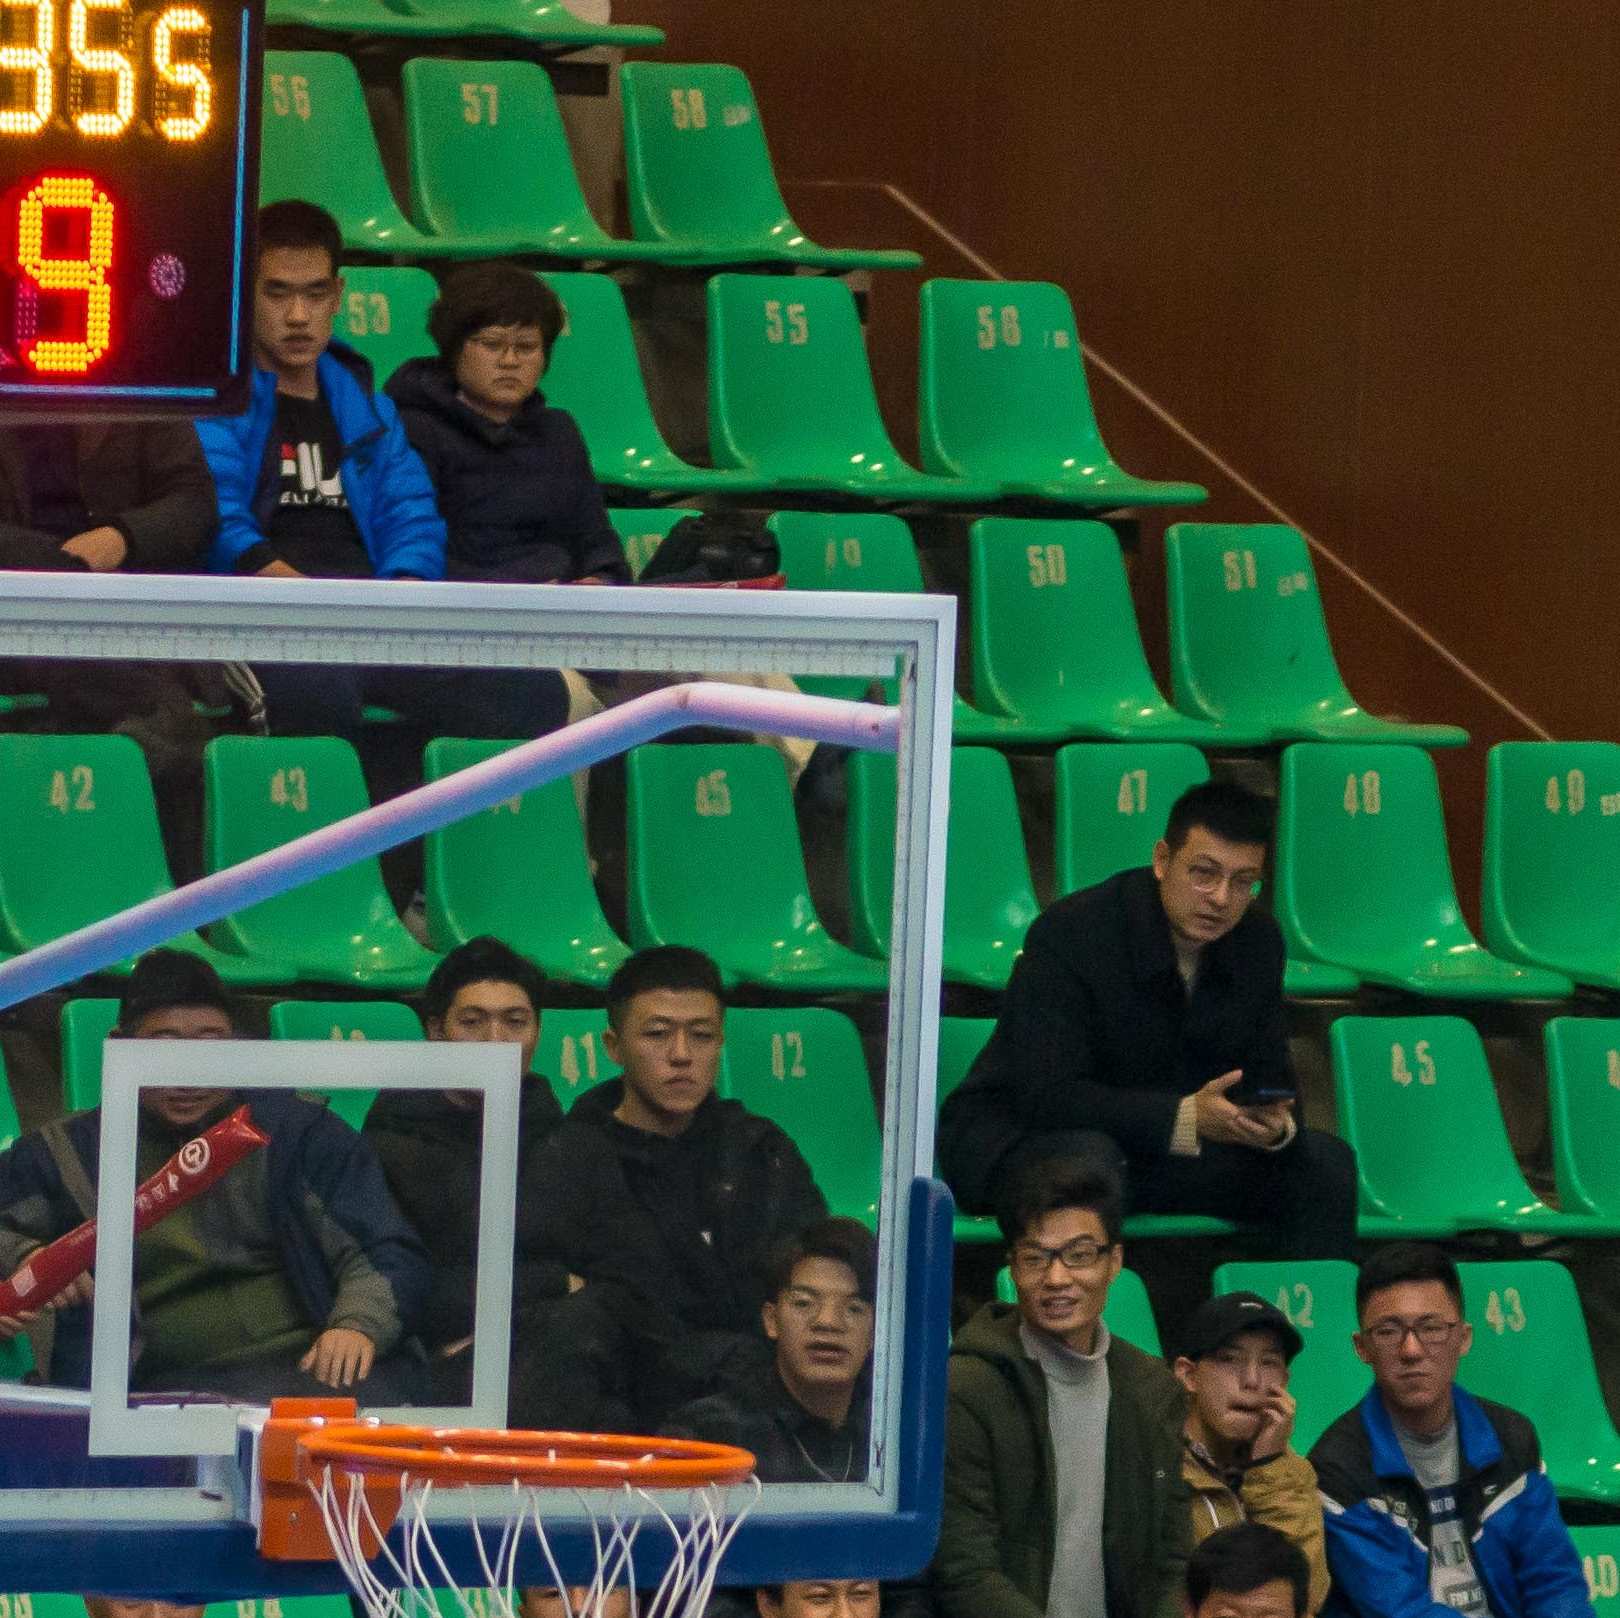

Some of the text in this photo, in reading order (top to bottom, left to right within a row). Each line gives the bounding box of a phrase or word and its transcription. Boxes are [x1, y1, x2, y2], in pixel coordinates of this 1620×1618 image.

[462, 84, 498, 126] 57
[765, 300, 808, 345] 55
[50, 765, 95, 814] 42
[1486, 1287, 1527, 1335] 43
